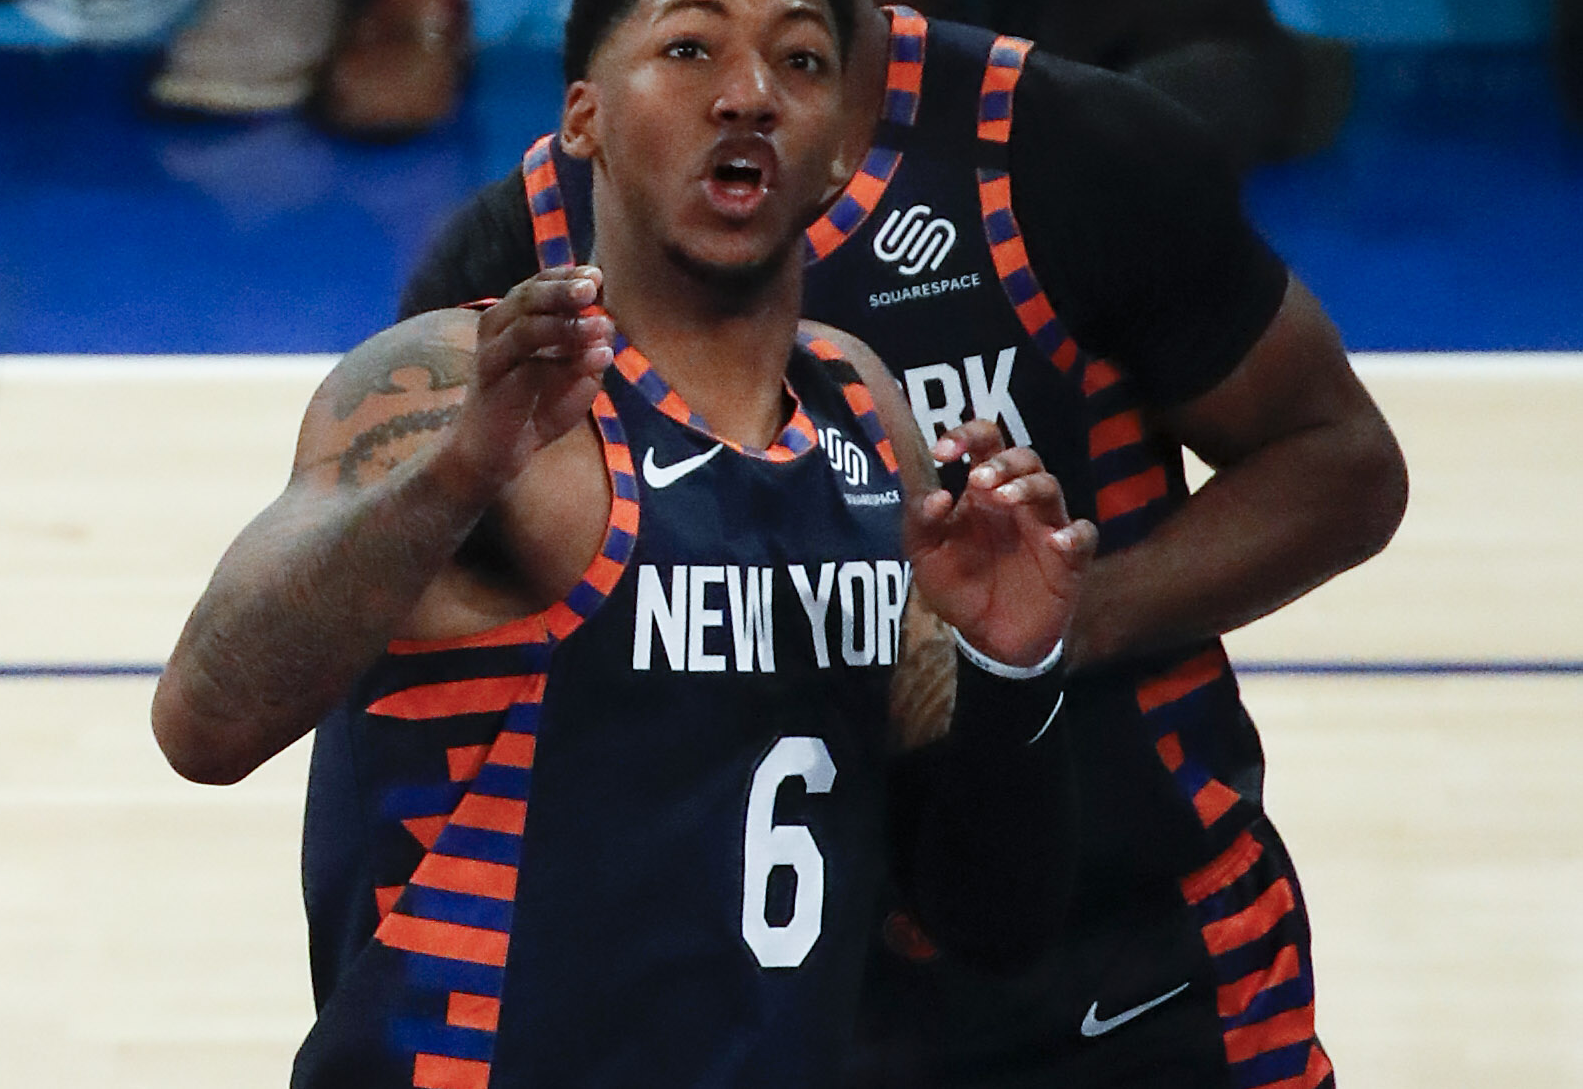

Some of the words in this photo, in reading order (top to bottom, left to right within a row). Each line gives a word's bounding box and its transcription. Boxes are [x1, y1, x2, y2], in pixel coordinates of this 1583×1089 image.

[868, 272, 981, 308] SQUARESPACE
[632, 563, 776, 673] NEW
[742, 736, 837, 968] 6
